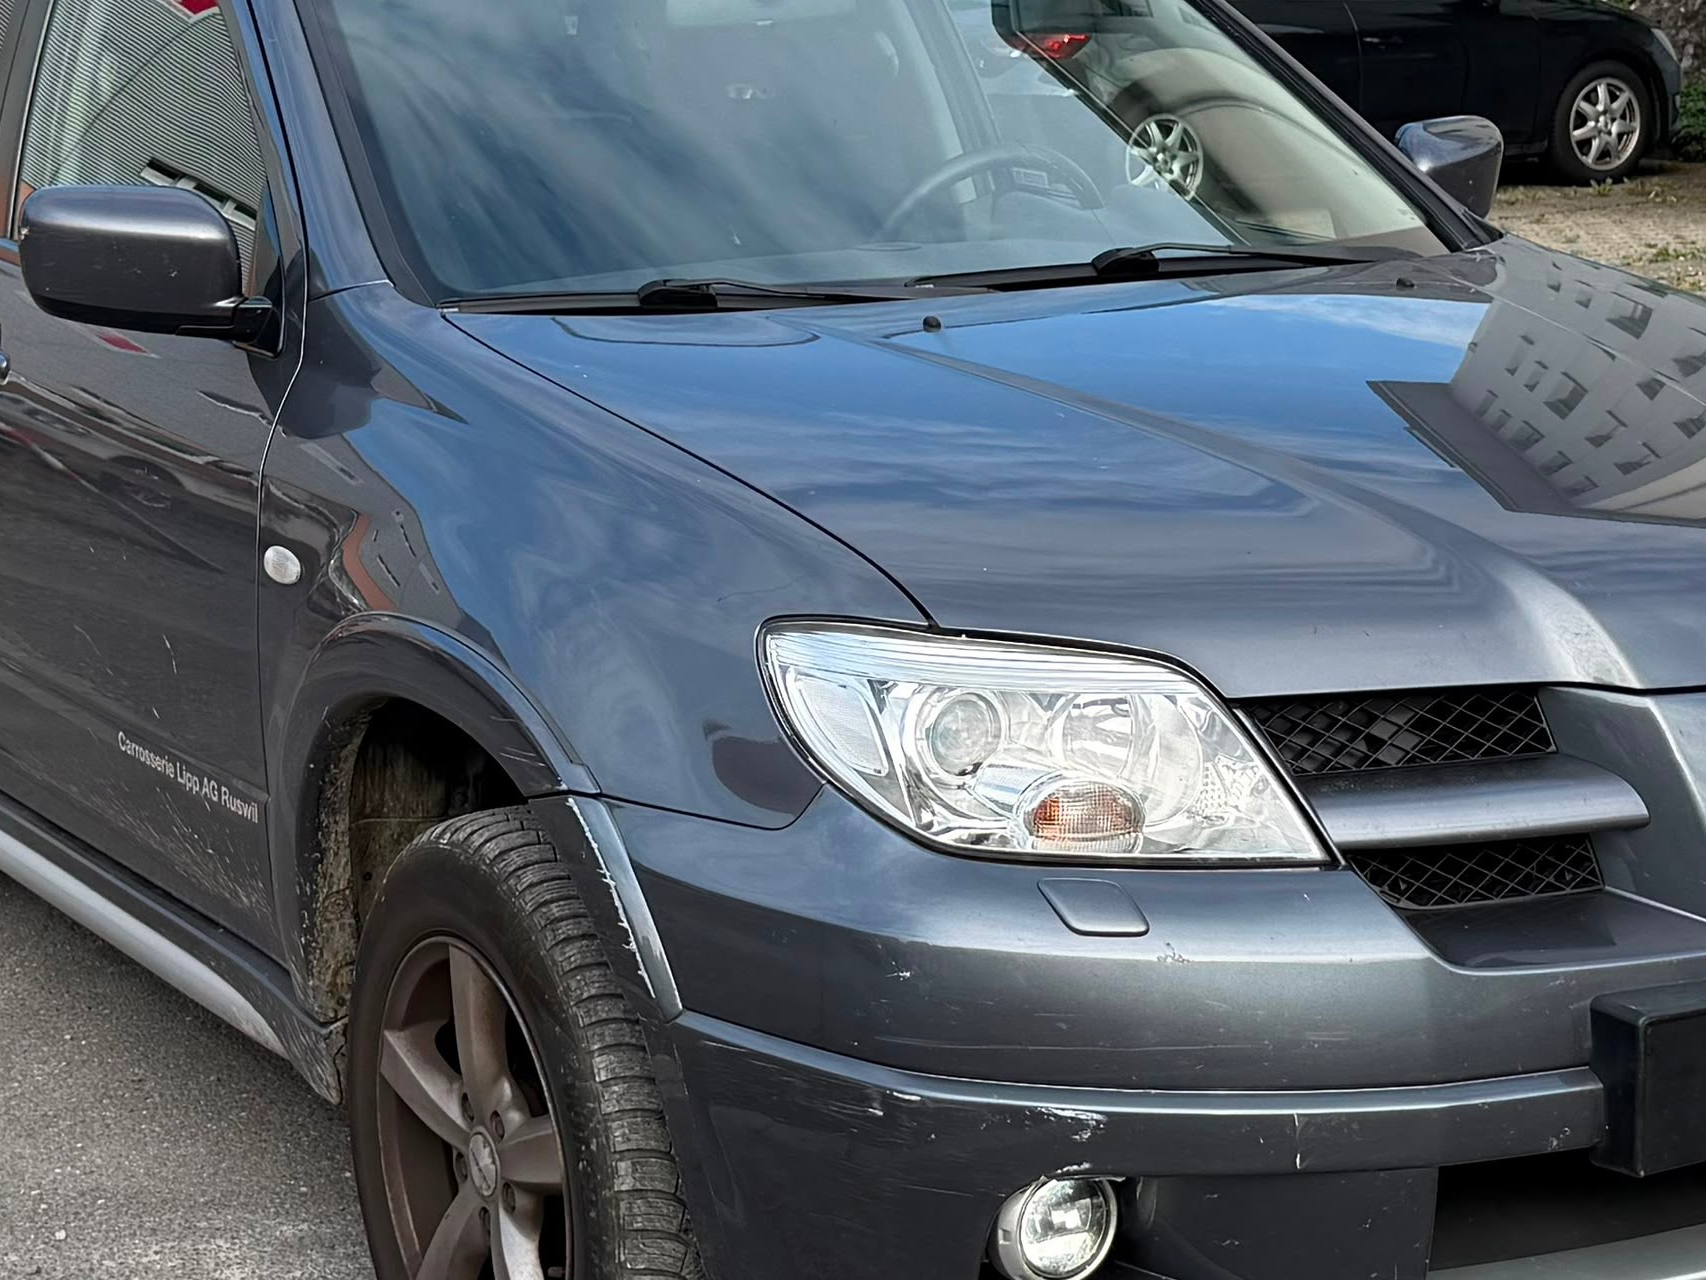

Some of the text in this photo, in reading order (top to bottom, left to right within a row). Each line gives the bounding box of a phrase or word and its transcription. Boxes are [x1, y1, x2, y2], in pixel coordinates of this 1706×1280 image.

[118, 731, 259, 824] Carrosserie Lipp AG Ruswil
